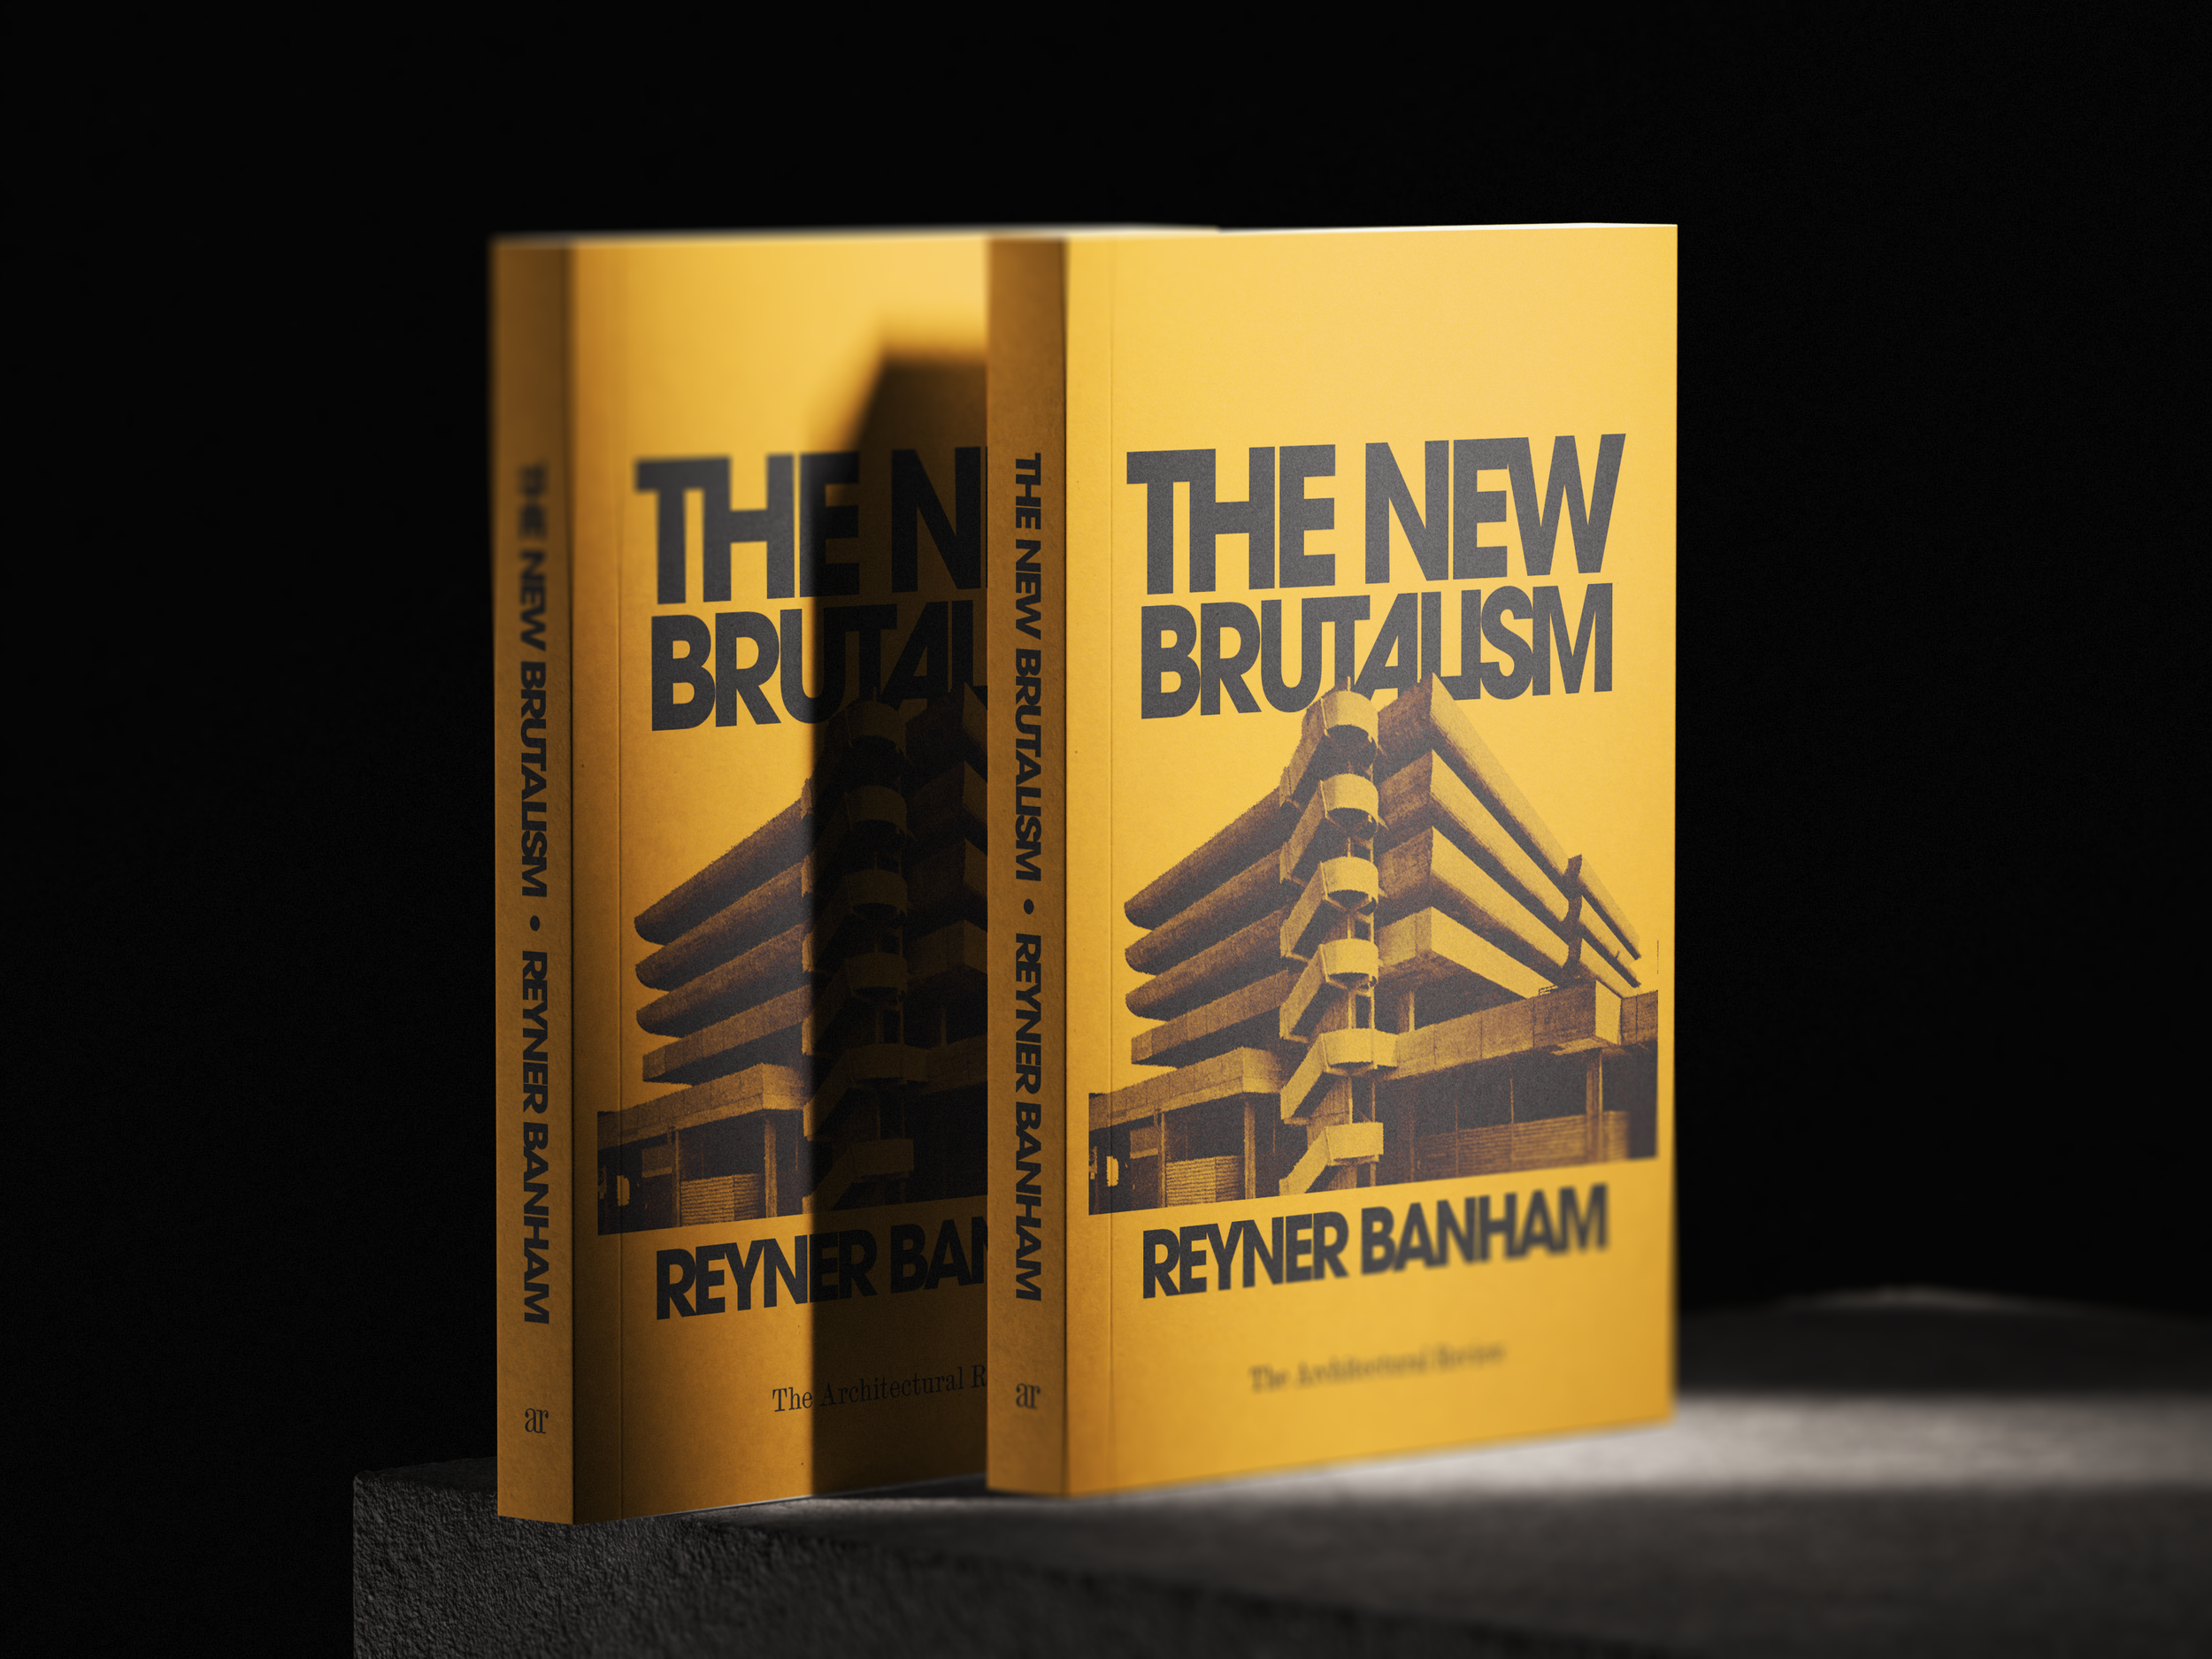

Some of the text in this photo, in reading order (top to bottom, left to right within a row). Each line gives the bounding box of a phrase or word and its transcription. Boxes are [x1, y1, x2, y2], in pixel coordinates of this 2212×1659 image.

[634, 451, 859, 604] THE
[1126, 434, 1626, 595] THE NEW
[519, 548, 547, 652] NEW
[1141, 583, 1613, 719] BRUTALISM
[520, 661, 548, 897] BRUTALISM
[1015, 453, 1041, 1302] THE NEW BRUTALISM REYNER BANHAM
[522, 950, 549, 1114] REYNER
[524, 1121, 549, 1325] BANHAM
[657, 1229, 878, 1320] REYNER
[1143, 1182, 1609, 1299] REYNER BANHAM
[525, 1407, 549, 1434] ar
[772, 1386, 813, 1412] The
[819, 1367, 964, 1407] Architectural
[1015, 1381, 1041, 1409] ar
